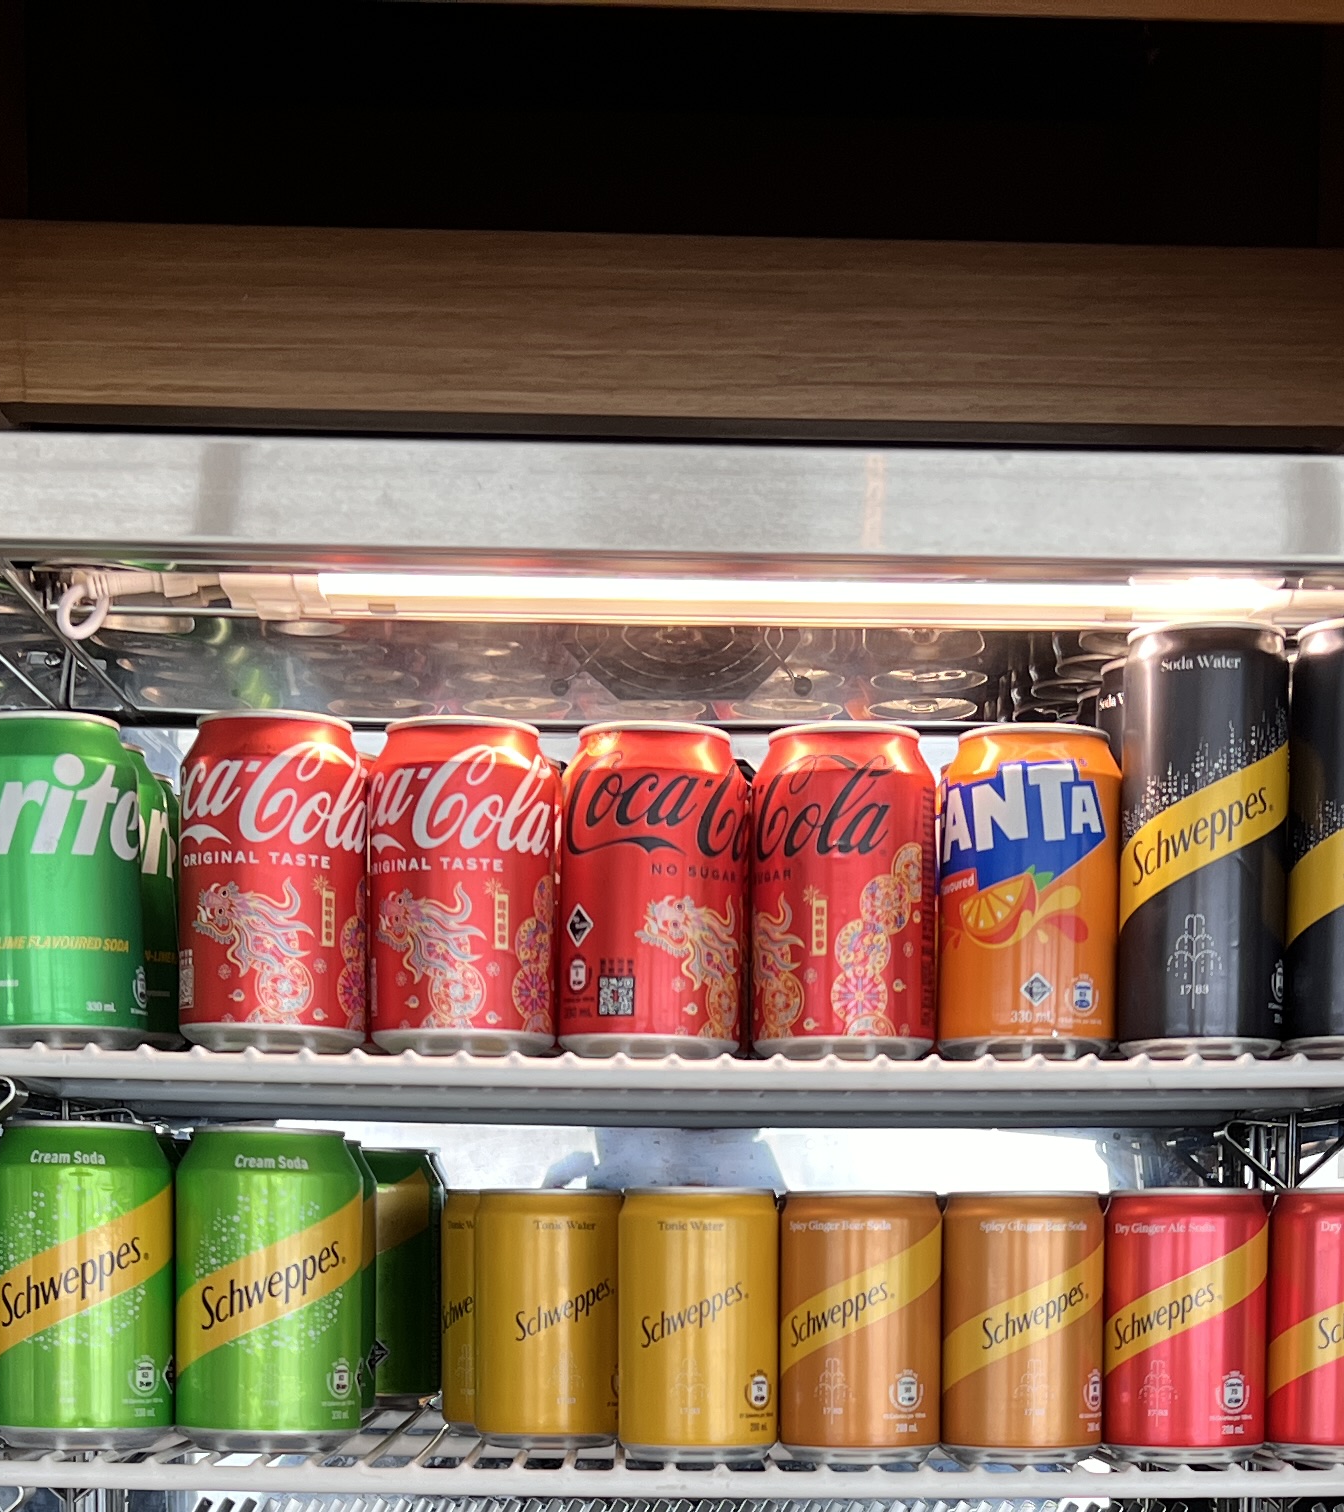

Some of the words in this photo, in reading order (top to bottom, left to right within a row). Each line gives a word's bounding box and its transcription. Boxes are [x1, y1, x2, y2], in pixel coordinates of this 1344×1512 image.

[1161, 656, 1193, 672] Soda
[1197, 655, 1242, 670] Water
[941, 762, 1103, 864] ANTA
[1132, 786, 1267, 887] Schweppes
[183, 851, 259, 868] ORIGINAL
[268, 851, 331, 869] TASTE
[439, 856, 504, 873] TASTE
[651, 863, 678, 876] NO
[28, 935, 102, 951] FLAVOURED
[103, 938, 130, 953] SODA
[30, 1150, 71, 1165] Cream
[73, 1150, 106, 1166] Soda
[234, 1153, 276, 1169] Cream
[278, 1155, 309, 1170] Soda
[566, 1219, 597, 1231] Water
[657, 1220, 688, 1231] Tonic
[690, 1220, 725, 1232] Water
[808, 1220, 840, 1232] Ginger
[1114, 1222, 1131, 1236] Dry
[1131, 1222, 1167, 1236] Ginger
[1168, 1222, 1186, 1233] Ale
[1320, 1221, 1342, 1235] Dry
[1, 1236, 142, 1327] Schweppes
[201, 1240, 340, 1331] Schweppes
[515, 1278, 612, 1342] Schweppes
[640, 1281, 743, 1349] Schweppes
[790, 1281, 889, 1348] Schweppes
[981, 1281, 1084, 1350] Schweppes
[1114, 1282, 1215, 1351] Schweppes
